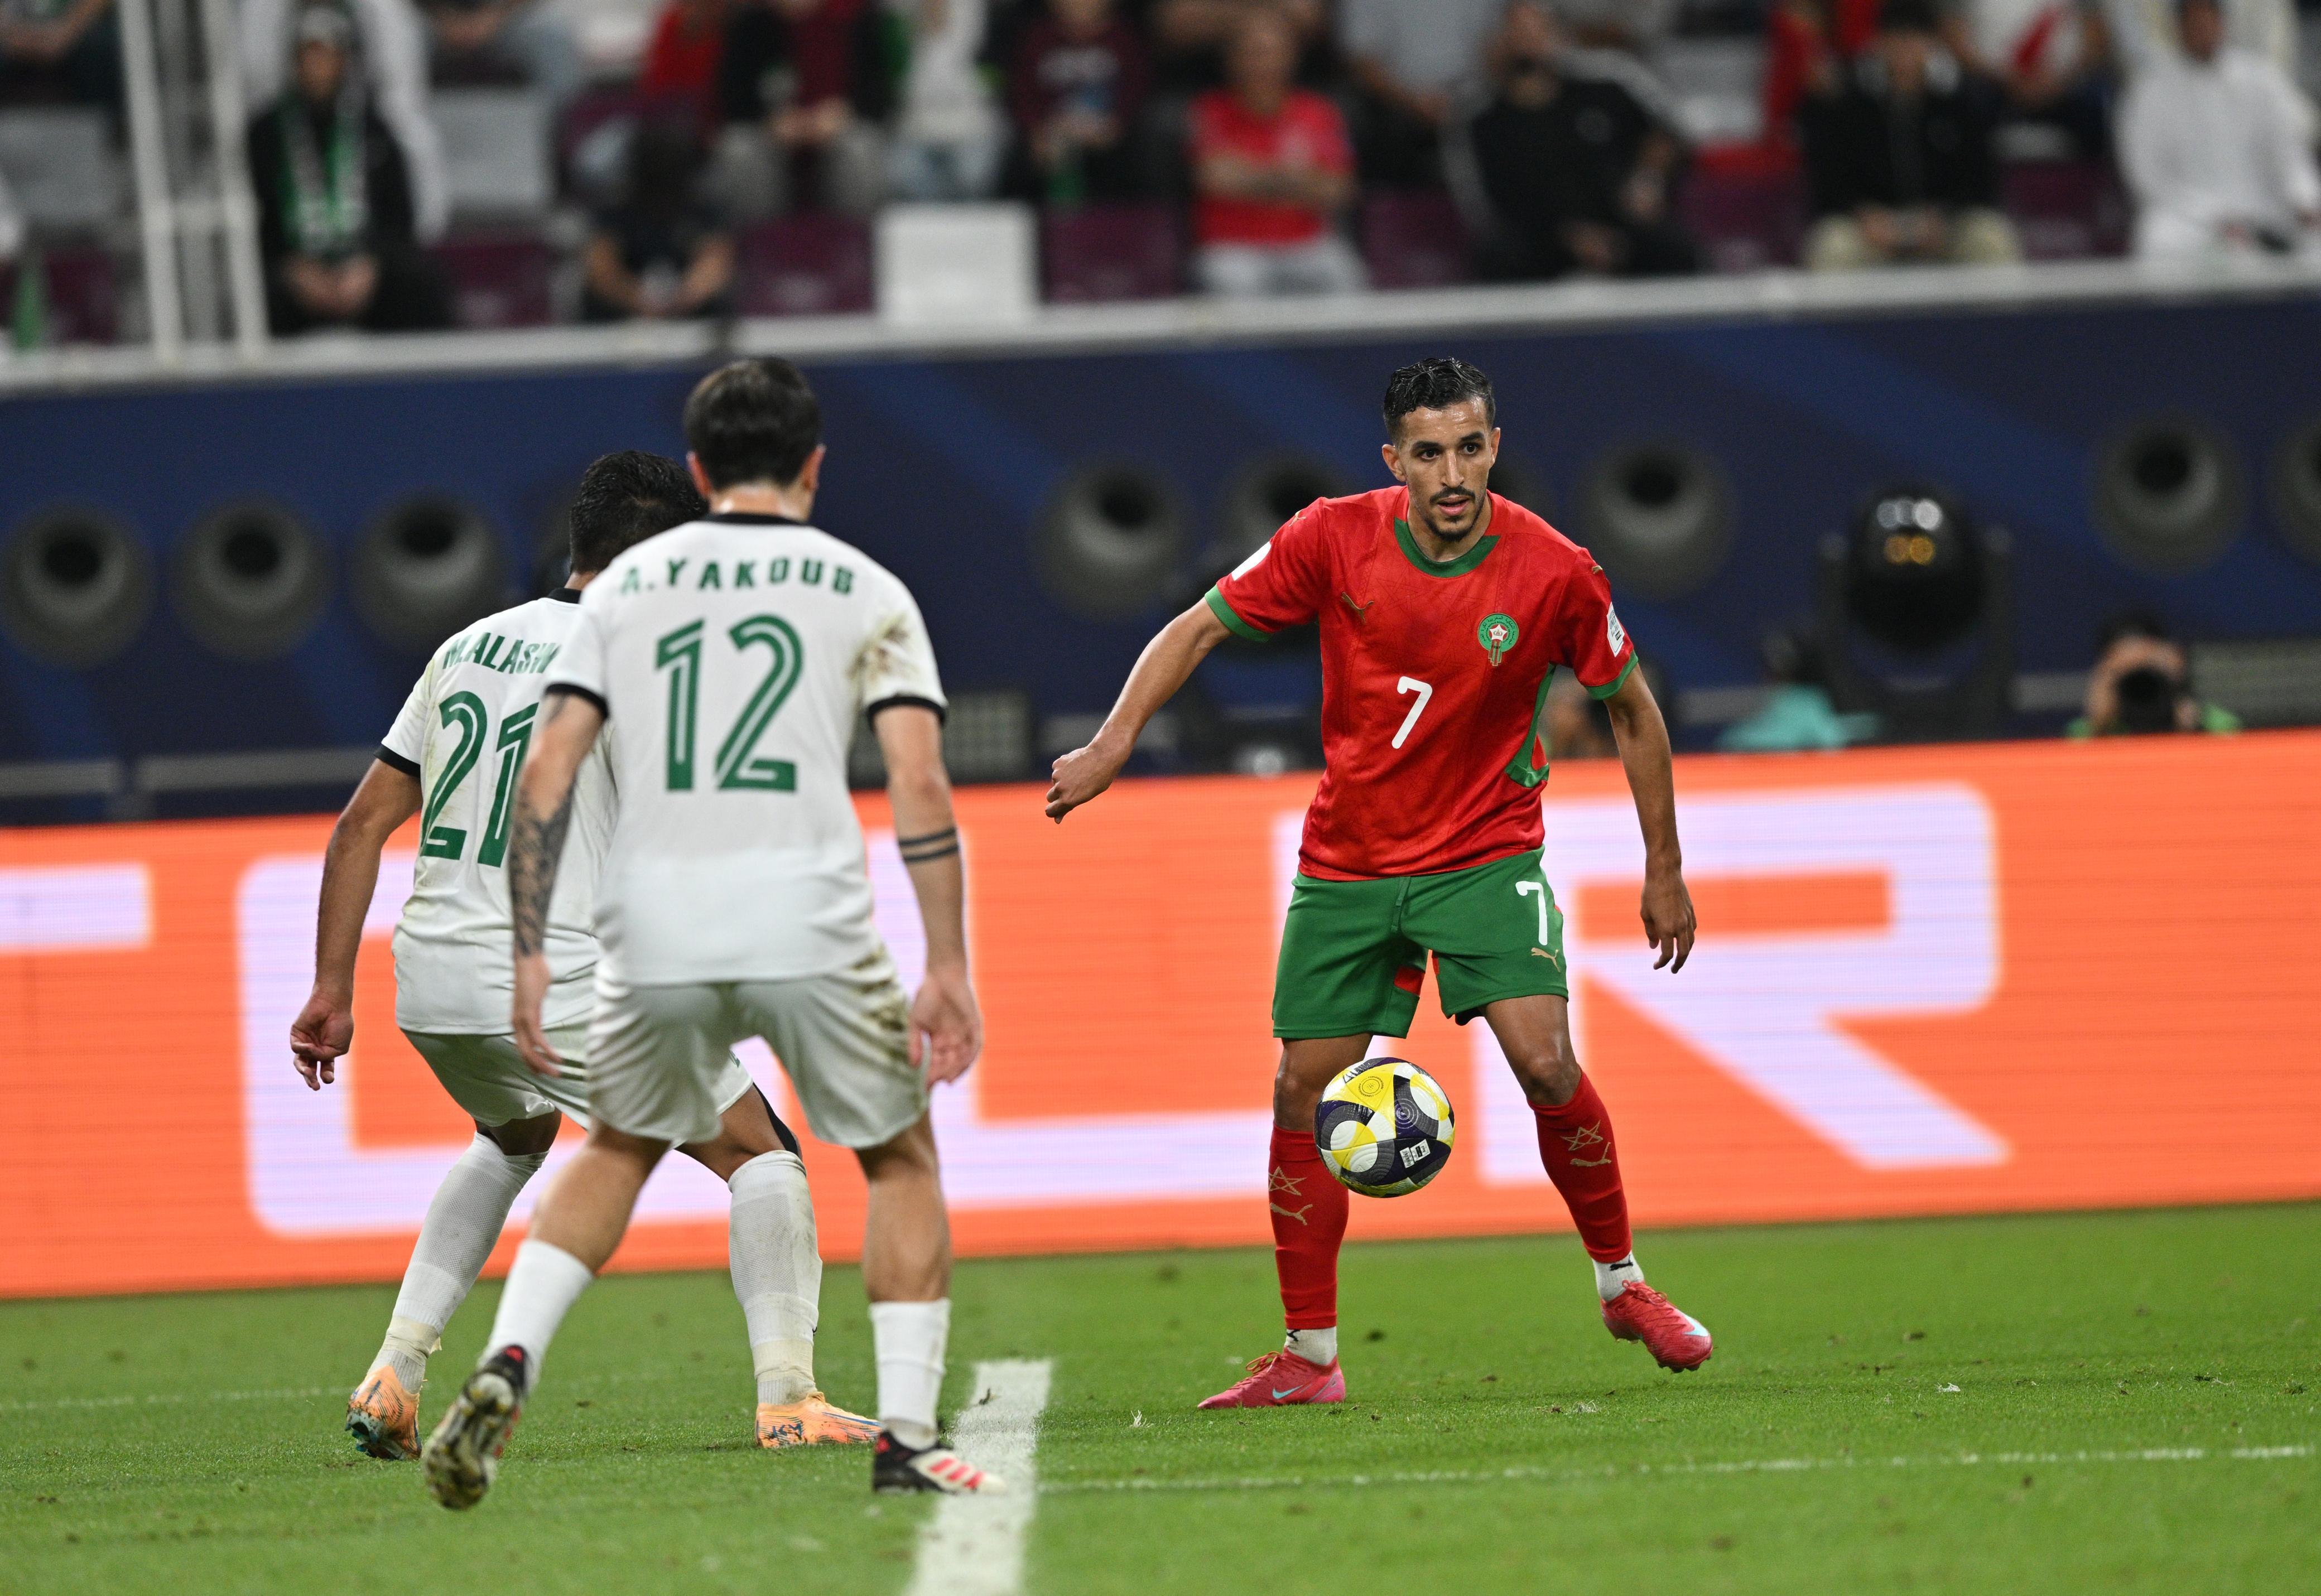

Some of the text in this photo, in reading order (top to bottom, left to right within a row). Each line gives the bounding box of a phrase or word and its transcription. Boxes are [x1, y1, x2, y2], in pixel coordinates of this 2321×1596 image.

[621, 557, 855, 596] A.YAKOUB
[655, 614, 802, 792] 12
[1391, 676, 1433, 749] 7
[420, 691, 539, 868] 21
[1515, 881, 1548, 946] 7
